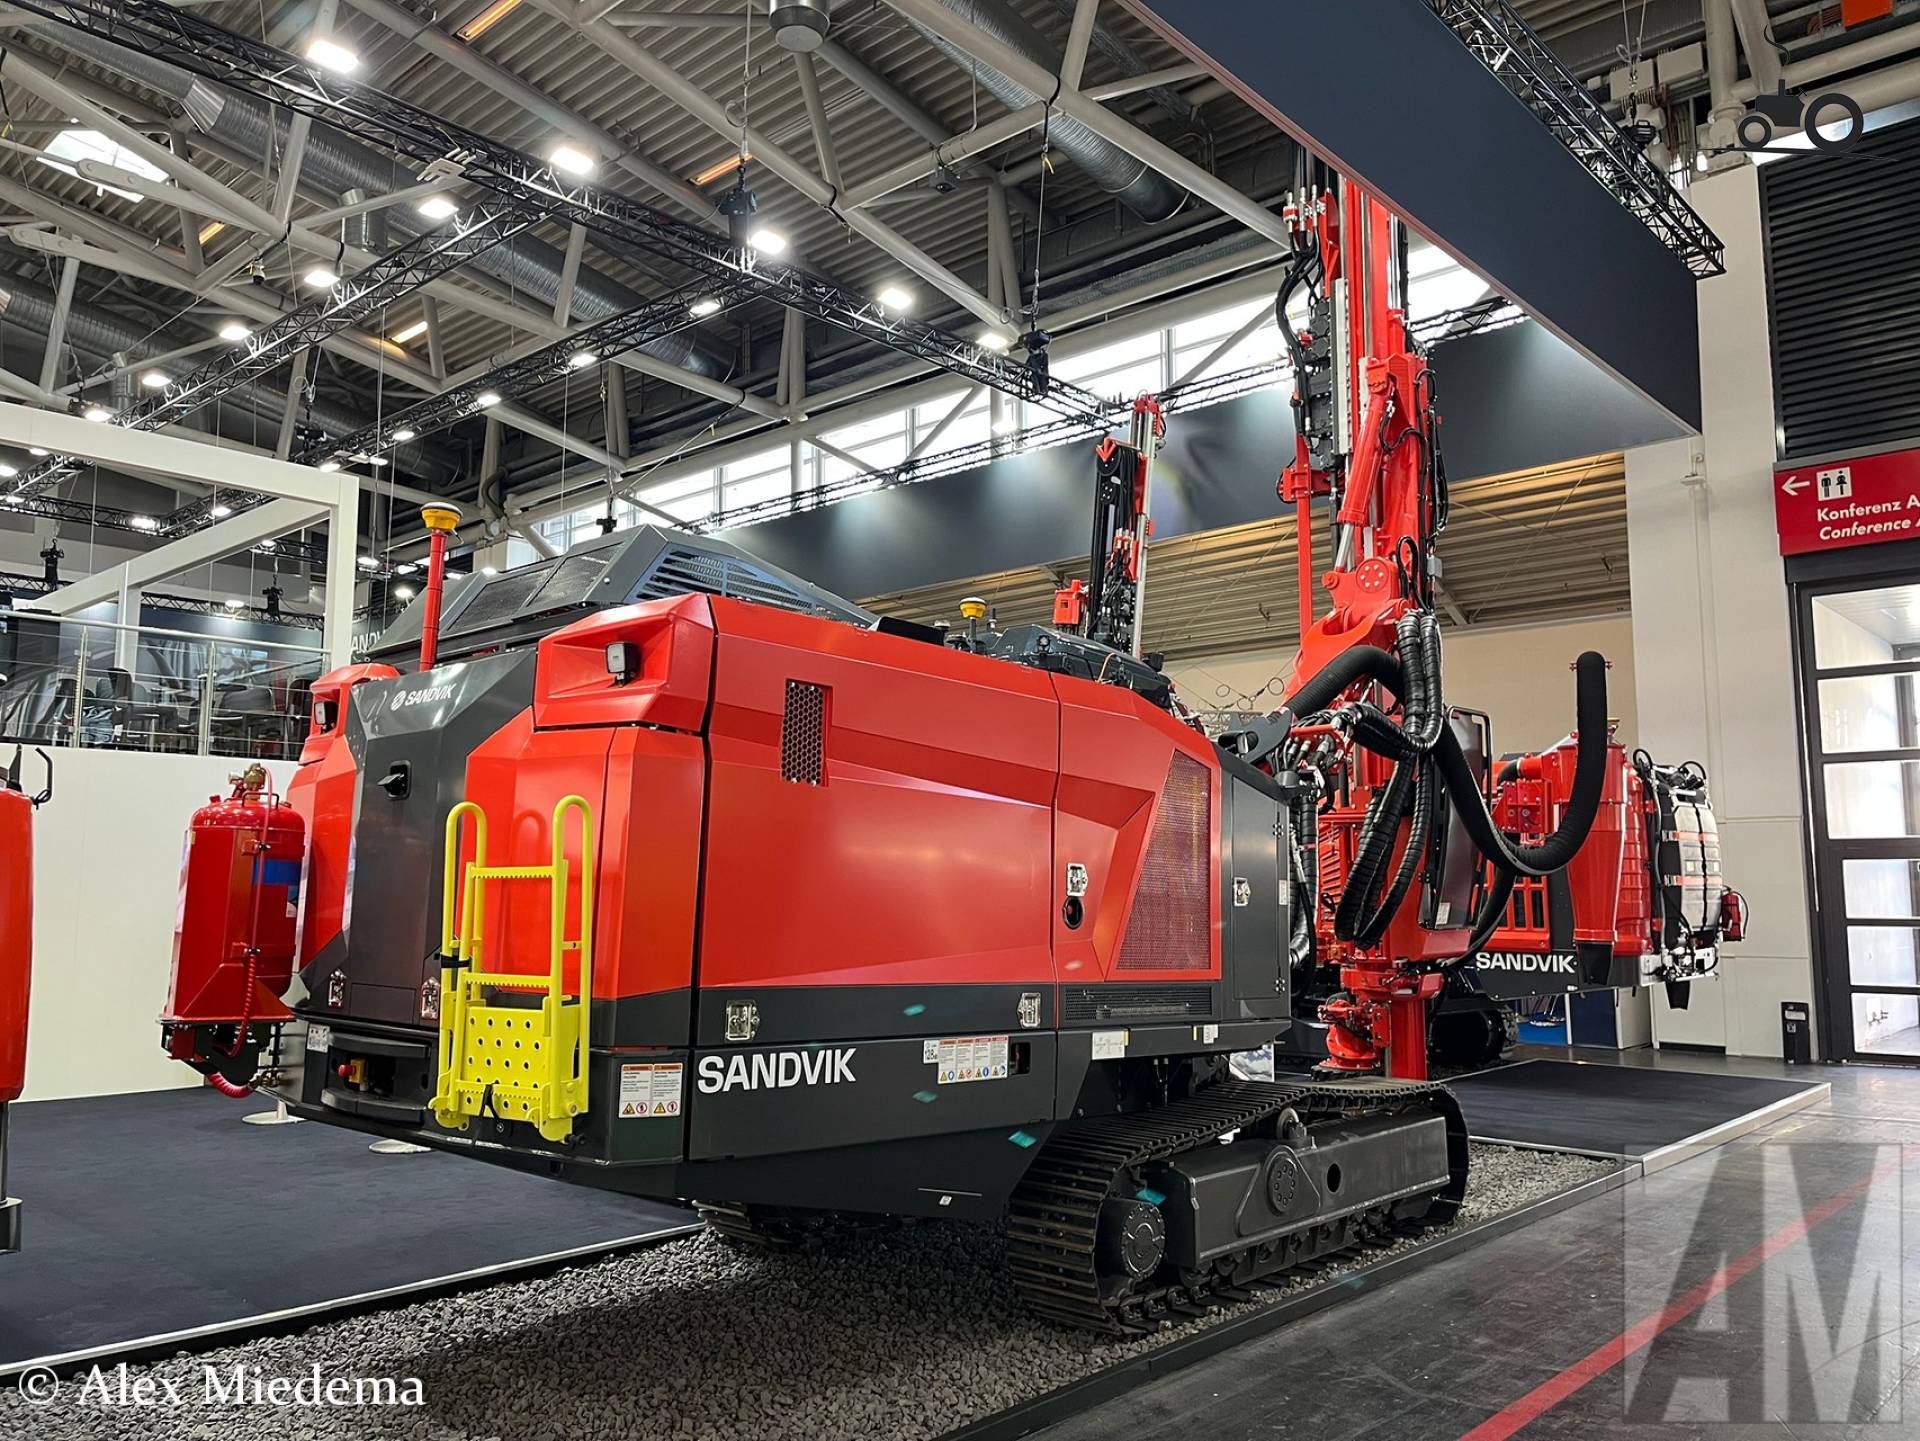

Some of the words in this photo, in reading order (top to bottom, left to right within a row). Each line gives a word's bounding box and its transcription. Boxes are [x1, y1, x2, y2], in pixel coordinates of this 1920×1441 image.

[1817, 502, 1902, 522] Konferenz
[1819, 518, 1911, 540] Conference
[405, 683, 457, 706] SANDVIK
[1475, 952, 1576, 974] SANDVIK
[697, 1048, 857, 1094] SANDVIK
